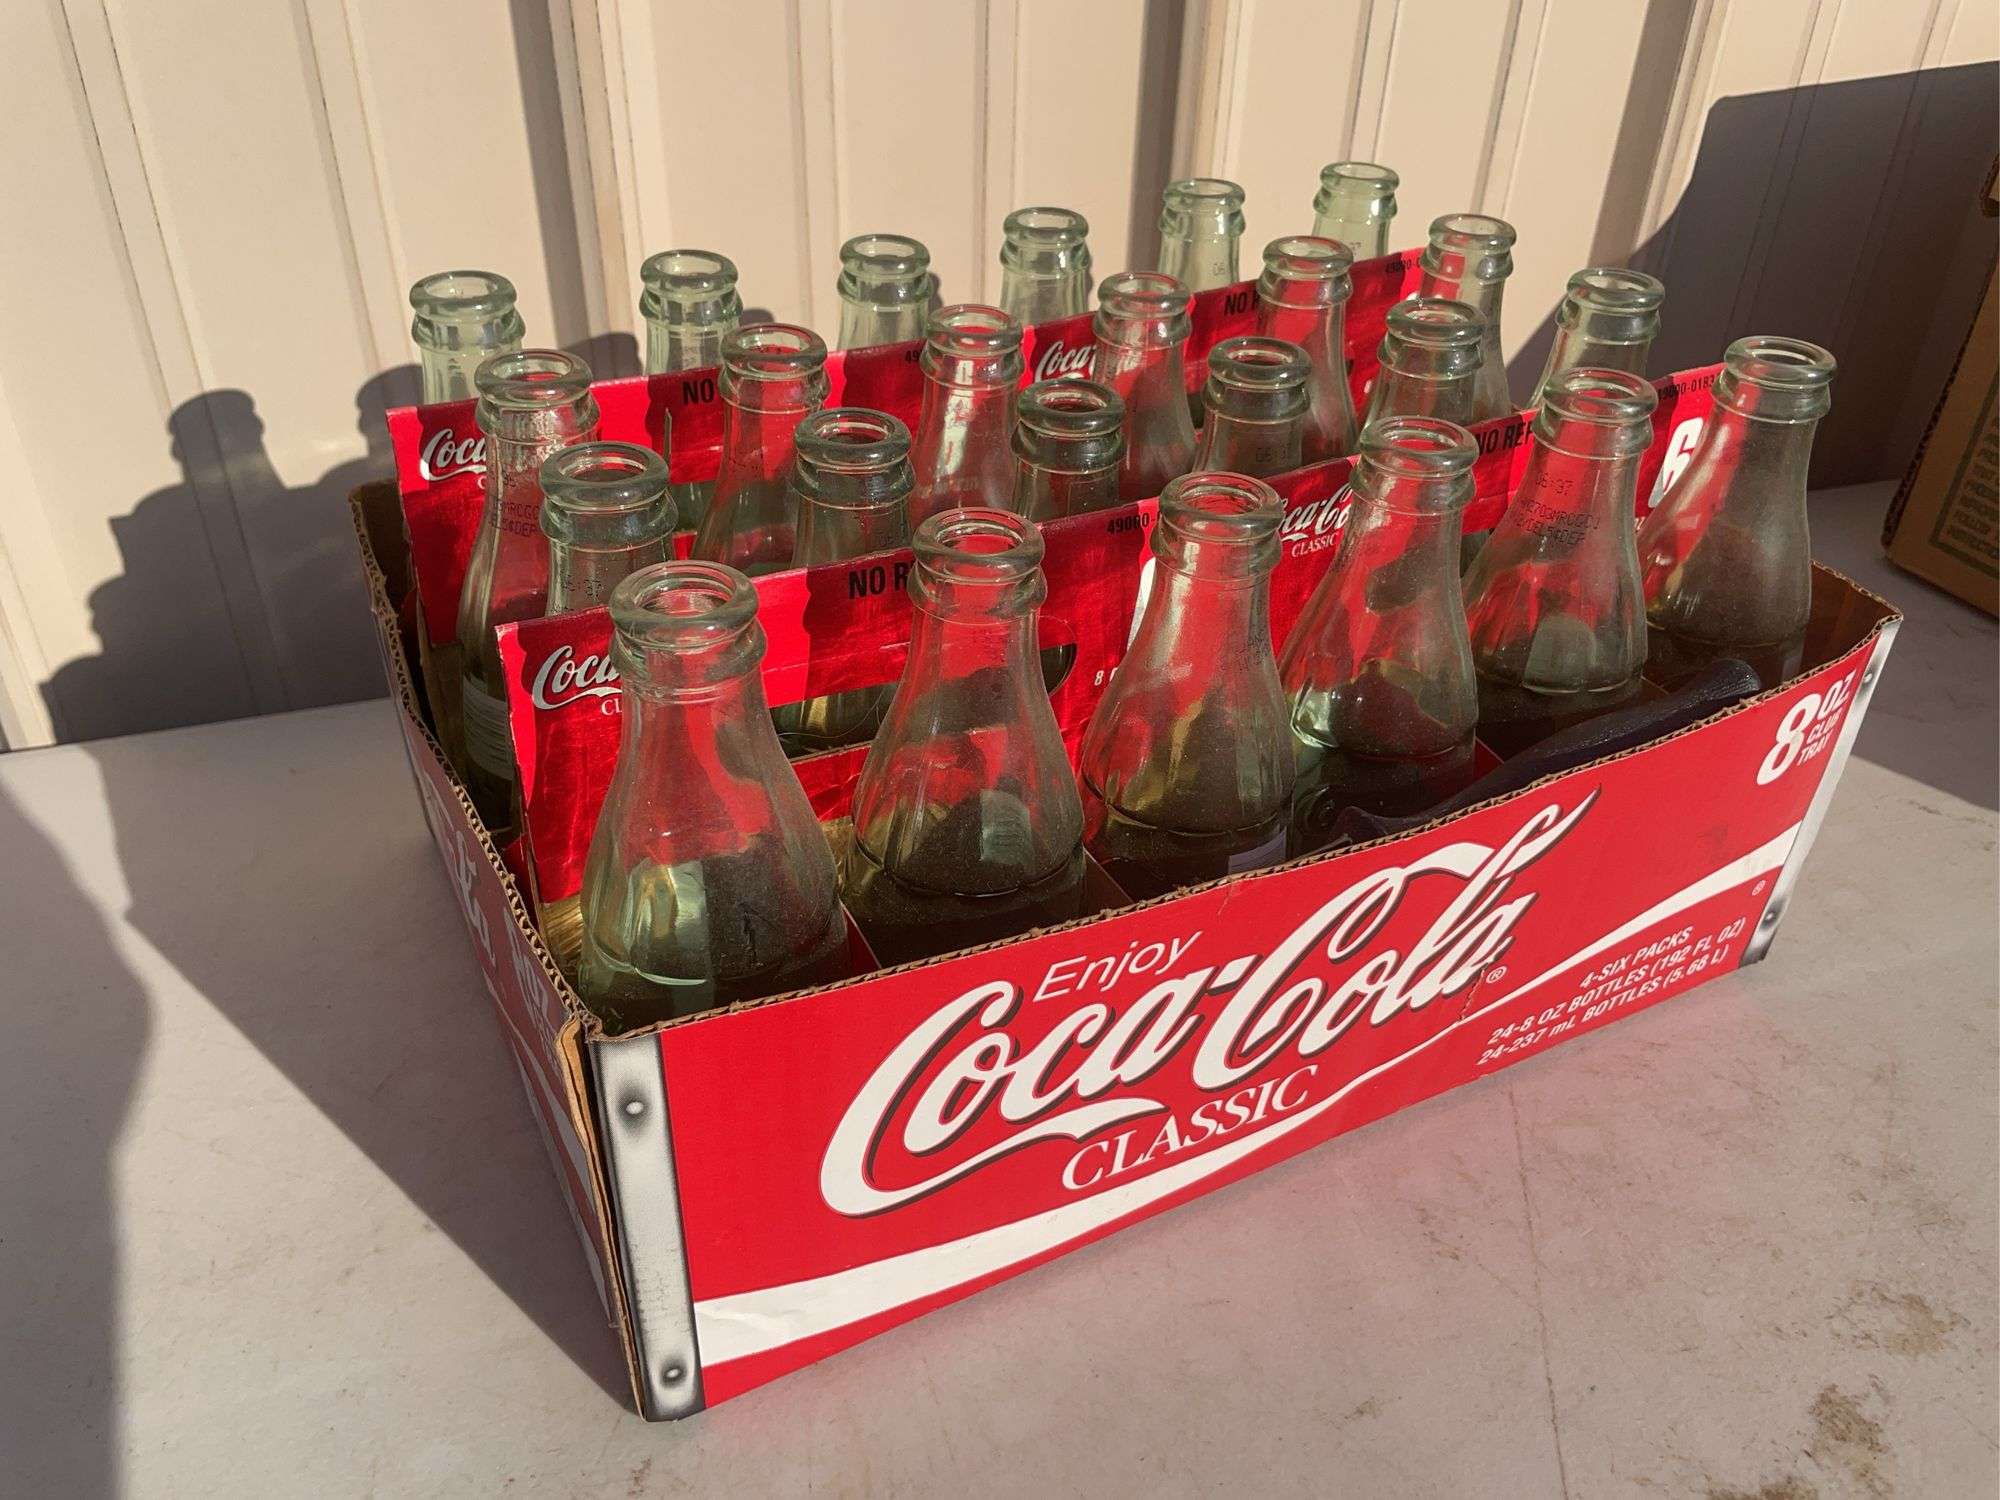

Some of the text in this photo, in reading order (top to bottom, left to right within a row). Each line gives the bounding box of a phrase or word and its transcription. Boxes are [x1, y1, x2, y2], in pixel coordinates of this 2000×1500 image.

[1224, 291, 1248, 317] NO
[682, 378, 715, 405] NO
[1291, 531, 1340, 558] CLASSIC
[849, 566, 886, 599] NO
[1093, 670, 1105, 686] 8
[1756, 668, 1857, 786] 8 OZ
[1033, 930, 1202, 1003] Enjoy
[1487, 917, 1746, 1045] 24-8 OZ BOTTLES (192 FL OZ)
[1580, 926, 1694, 988] 4-SIX PACKS
[818, 786, 1602, 1217] Coca-Cola
[1475, 1027, 1549, 1066] 24-237
[1548, 1014, 1577, 1038] mL
[1581, 975, 1662, 1023] BOTTLES
[1710, 944, 1729, 965] L)
[1061, 1064, 1319, 1192] CLASSIC
